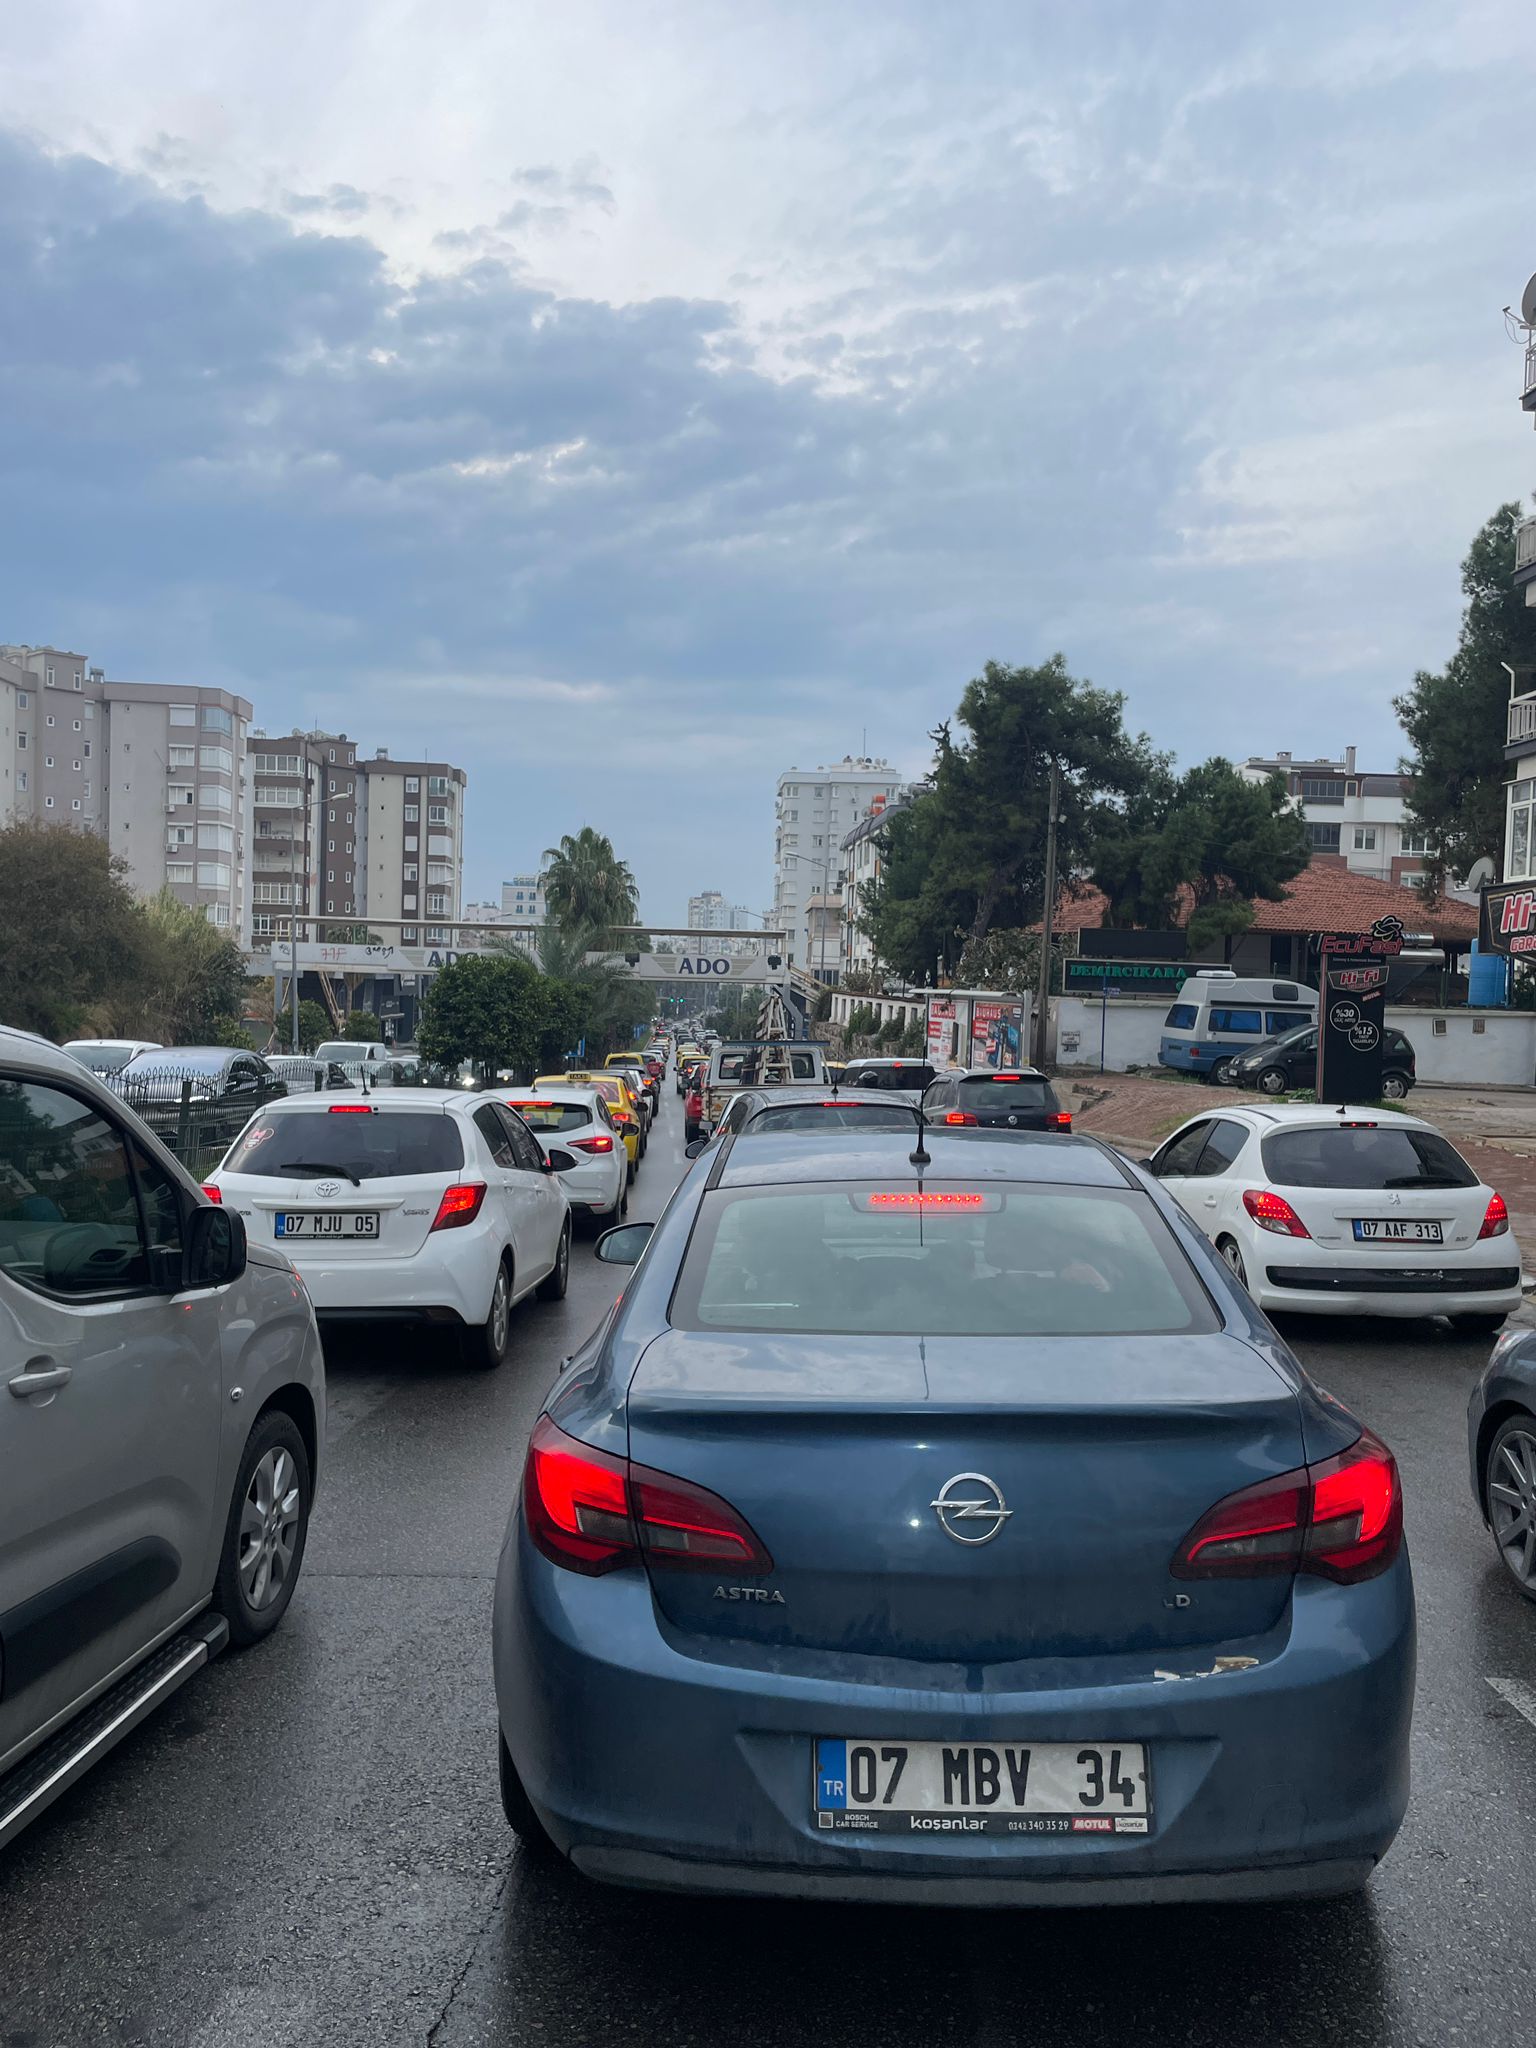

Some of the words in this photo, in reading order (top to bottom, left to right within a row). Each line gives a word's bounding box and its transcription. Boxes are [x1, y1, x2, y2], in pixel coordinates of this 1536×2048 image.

[1321, 936, 1402, 954] EcuFast
[678, 957, 730, 974] ADO
[1340, 968, 1380, 985] Hi-Fi
[1336, 1009, 1355, 1018] %30
[1354, 1027, 1373, 1035] %15
[286, 1216, 304, 1232] 07
[313, 1216, 342, 1232] MJU
[355, 1216, 374, 1232] 05
[1363, 1222, 1378, 1236] 07
[1385, 1223, 1407, 1237] AAF
[1415, 1225, 1439, 1239] 313
[712, 1586, 786, 1603] ASTRA
[824, 1780, 843, 1796] TR
[851, 1747, 908, 1804] 07
[942, 1748, 1031, 1806] MBV
[1077, 1749, 1135, 1807] 34
[851, 1821, 878, 1829] SERVICE
[910, 1815, 988, 1831] koşanlar
[1028, 1820, 1044, 1831] 340
[1046, 1820, 1056, 1831] 35
[1058, 1820, 1069, 1830] 29
[1073, 1819, 1111, 1829] MOTUL
